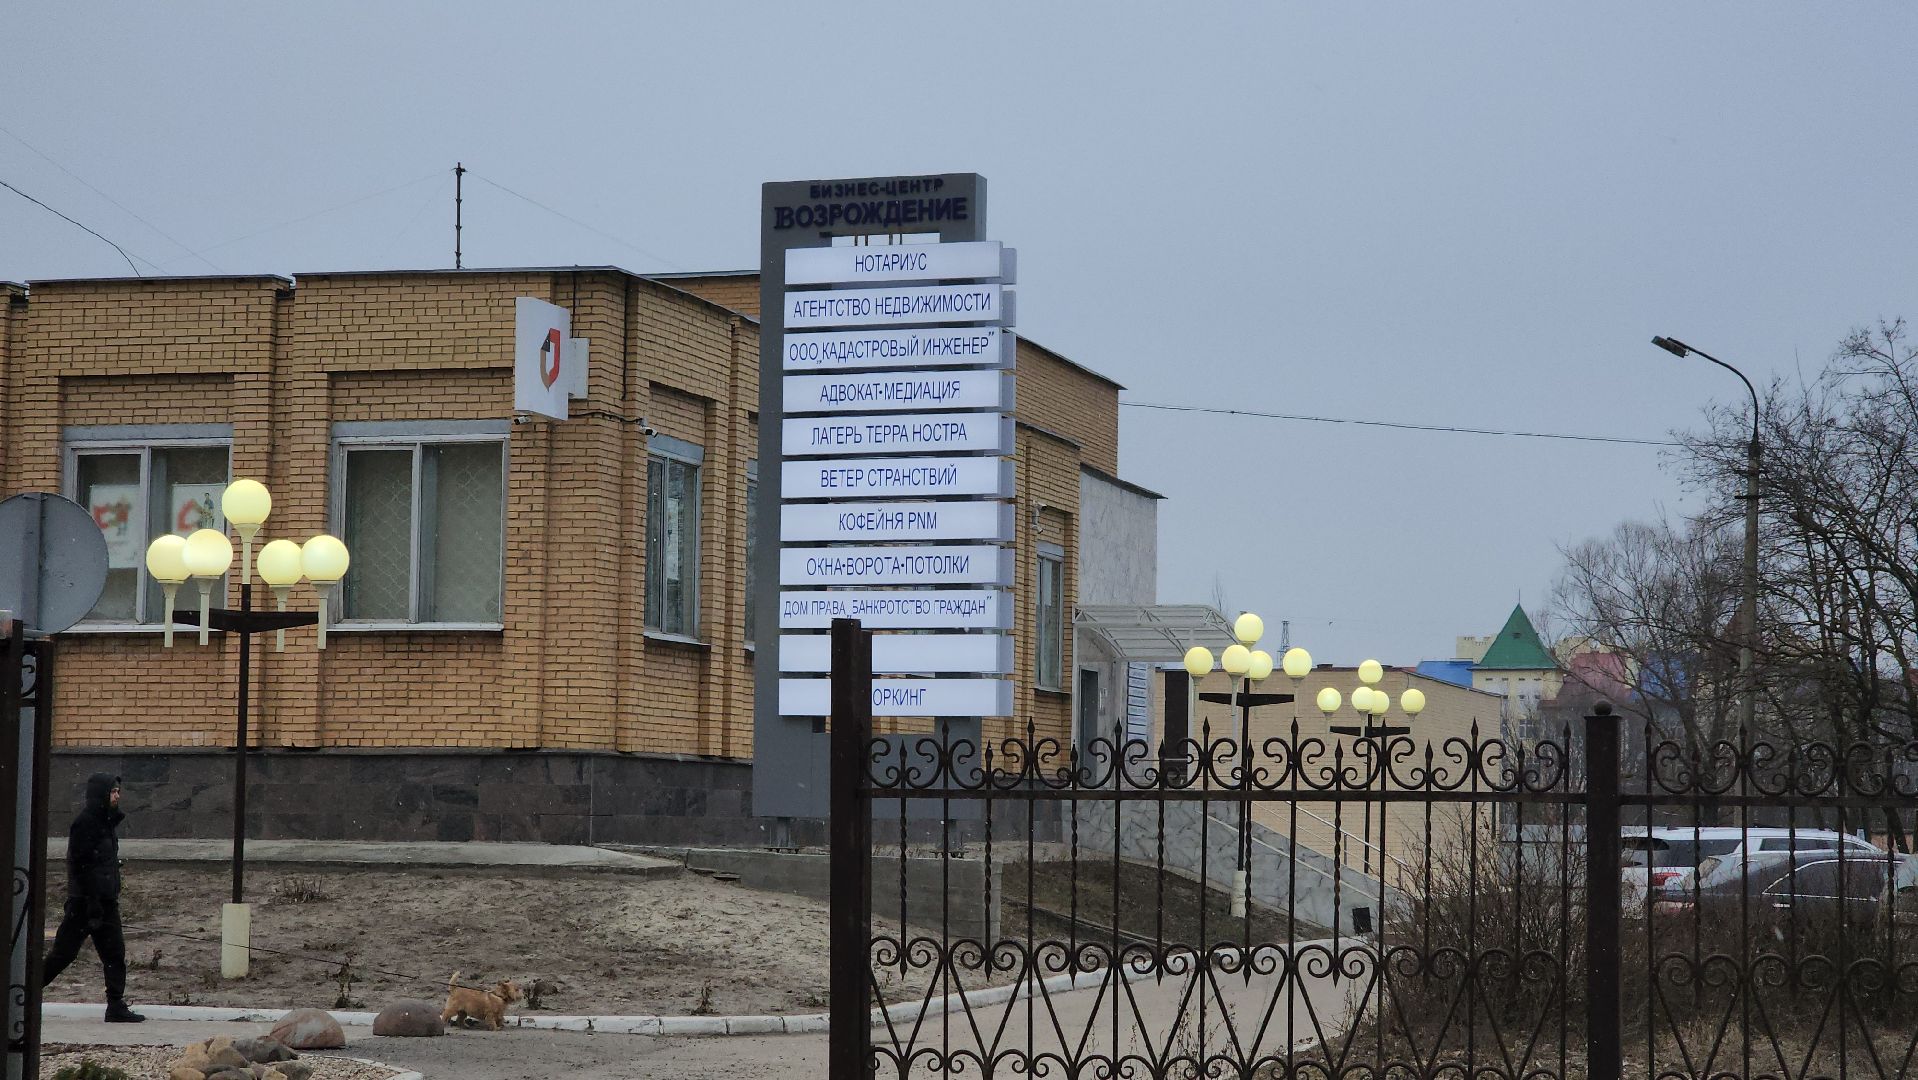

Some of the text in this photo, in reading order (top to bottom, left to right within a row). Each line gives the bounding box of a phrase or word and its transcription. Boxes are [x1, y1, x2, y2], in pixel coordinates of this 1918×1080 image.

[810, 178, 944, 199] БИЗНЕС-ЦЕНТР
[774, 197, 968, 229] ВОЗРОЖДЕНИЕ
[855, 253, 927, 272] НОТАРИУС
[794, 293, 991, 318] АГЕНТСТВО НЕДВИЖИМОСТИ
[812, 423, 967, 445] ЛАГЕРЬ ТЕРРА НОСТРА
[821, 464, 957, 487] ВЕТЕР СТРАНСТВИЙ
[839, 508, 937, 531] КОФЕЙНЯ PNM
[784, 601, 808, 618] ДОМ
[811, 600, 846, 616] ПРАВА
[873, 689, 926, 706] ОРКИНГ
